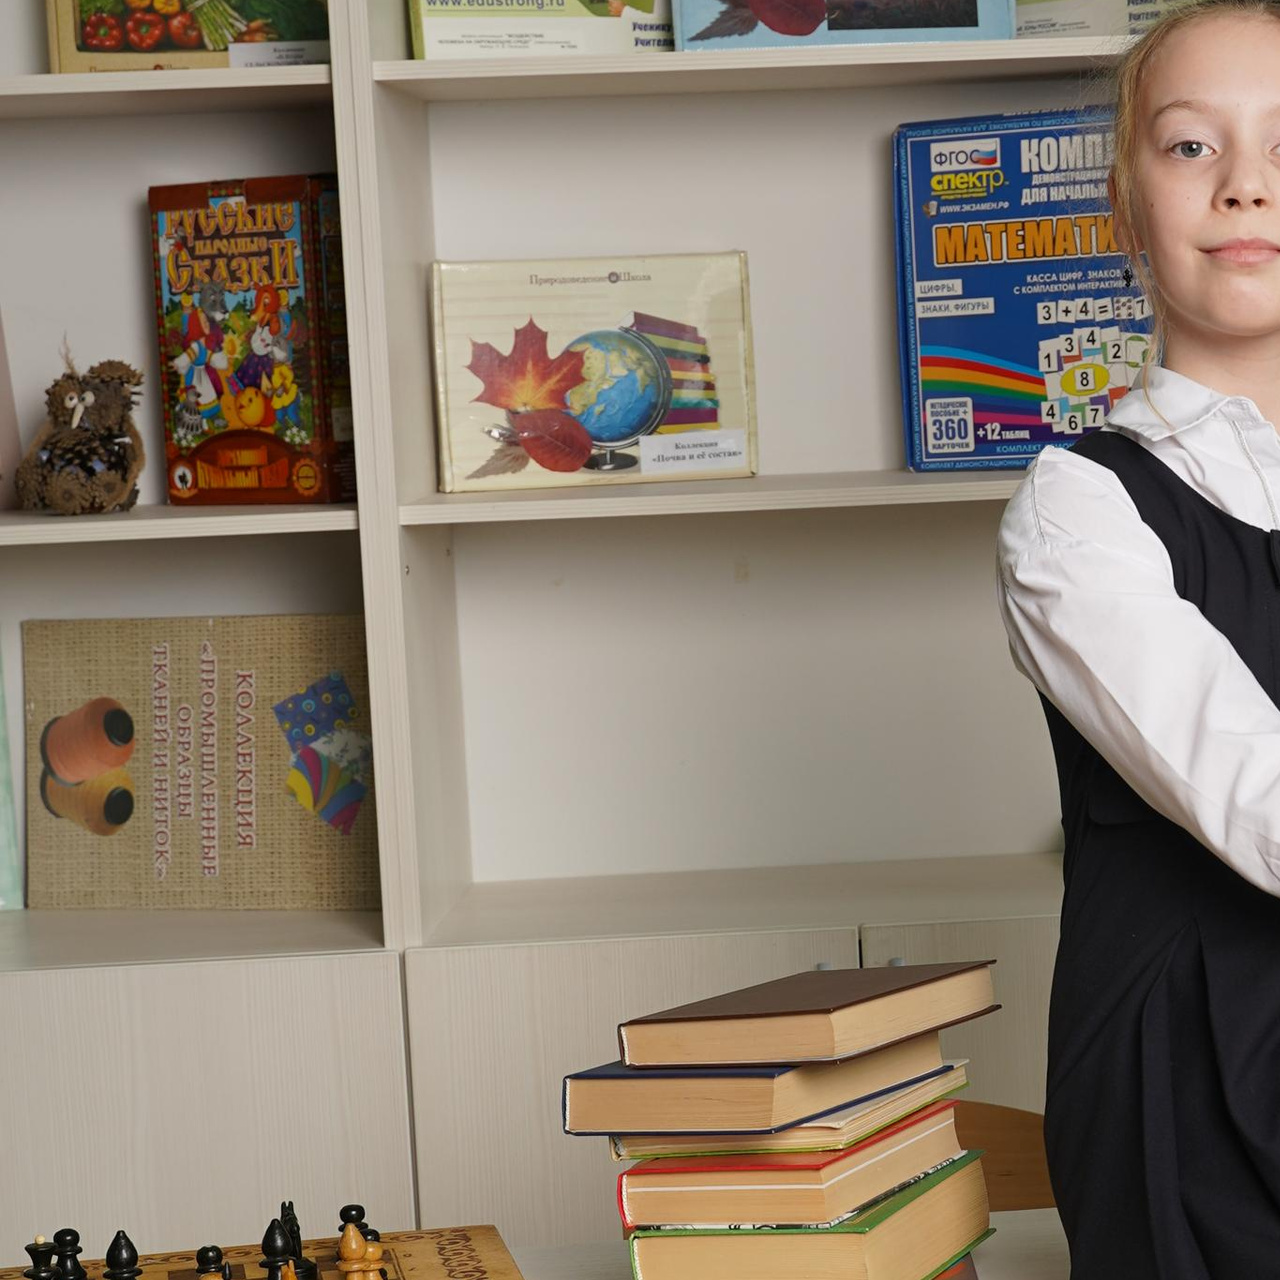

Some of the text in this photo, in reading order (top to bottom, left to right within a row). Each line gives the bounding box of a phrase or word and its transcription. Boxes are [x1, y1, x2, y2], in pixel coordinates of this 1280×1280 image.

[933, 150, 981, 167] ФГОС
[1021, 188, 1047, 206] ДЛЯ
[939, 201, 1010, 214] WWW.ЭКЗАМЕН.РФ
[165, 201, 295, 246] РУССКИЕ
[1026, 273, 1058, 283] КАССА
[1013, 283, 1076, 295] С КОМПЛЕКТОМ
[953, 301, 990, 313] ФИГУРЫ
[1042, 305, 1052, 321] 3
[1079, 301, 1090, 316] 4
[1136, 299, 1145, 315] 7
[1065, 337, 1074, 353] 3
[1087, 330, 1096, 345] 4
[1112, 343, 1121, 359] 2
[1044, 353, 1051, 369] 1
[1080, 372, 1090, 387] 8
[930, 401, 968, 410] МЕТОДИЧЕСКОЕ
[930, 409, 960, 418] ПОСОБИЕ
[1046, 405, 1056, 420] 4
[1068, 415, 1078, 431] 6
[1090, 408, 1099, 424] 7
[932, 419, 969, 442] 360
[932, 442, 970, 450] КАРТОЧЕК
[996, 444, 1041, 454] КОМПЛЕКТ
[921, 459, 1026, 470] КОМПЛЕКТ ДЕМОНСТРАЦИОННЫХ
[153, 643, 172, 880] ТКАНЕЙ И НИТОК»
[177, 704, 194, 820] ОБРАЗЦЫ
[201, 642, 218, 877] «ПРОМЫШЛЕННЫЕ
[236, 670, 256, 848] КОЛЛЕКЦИЯ
